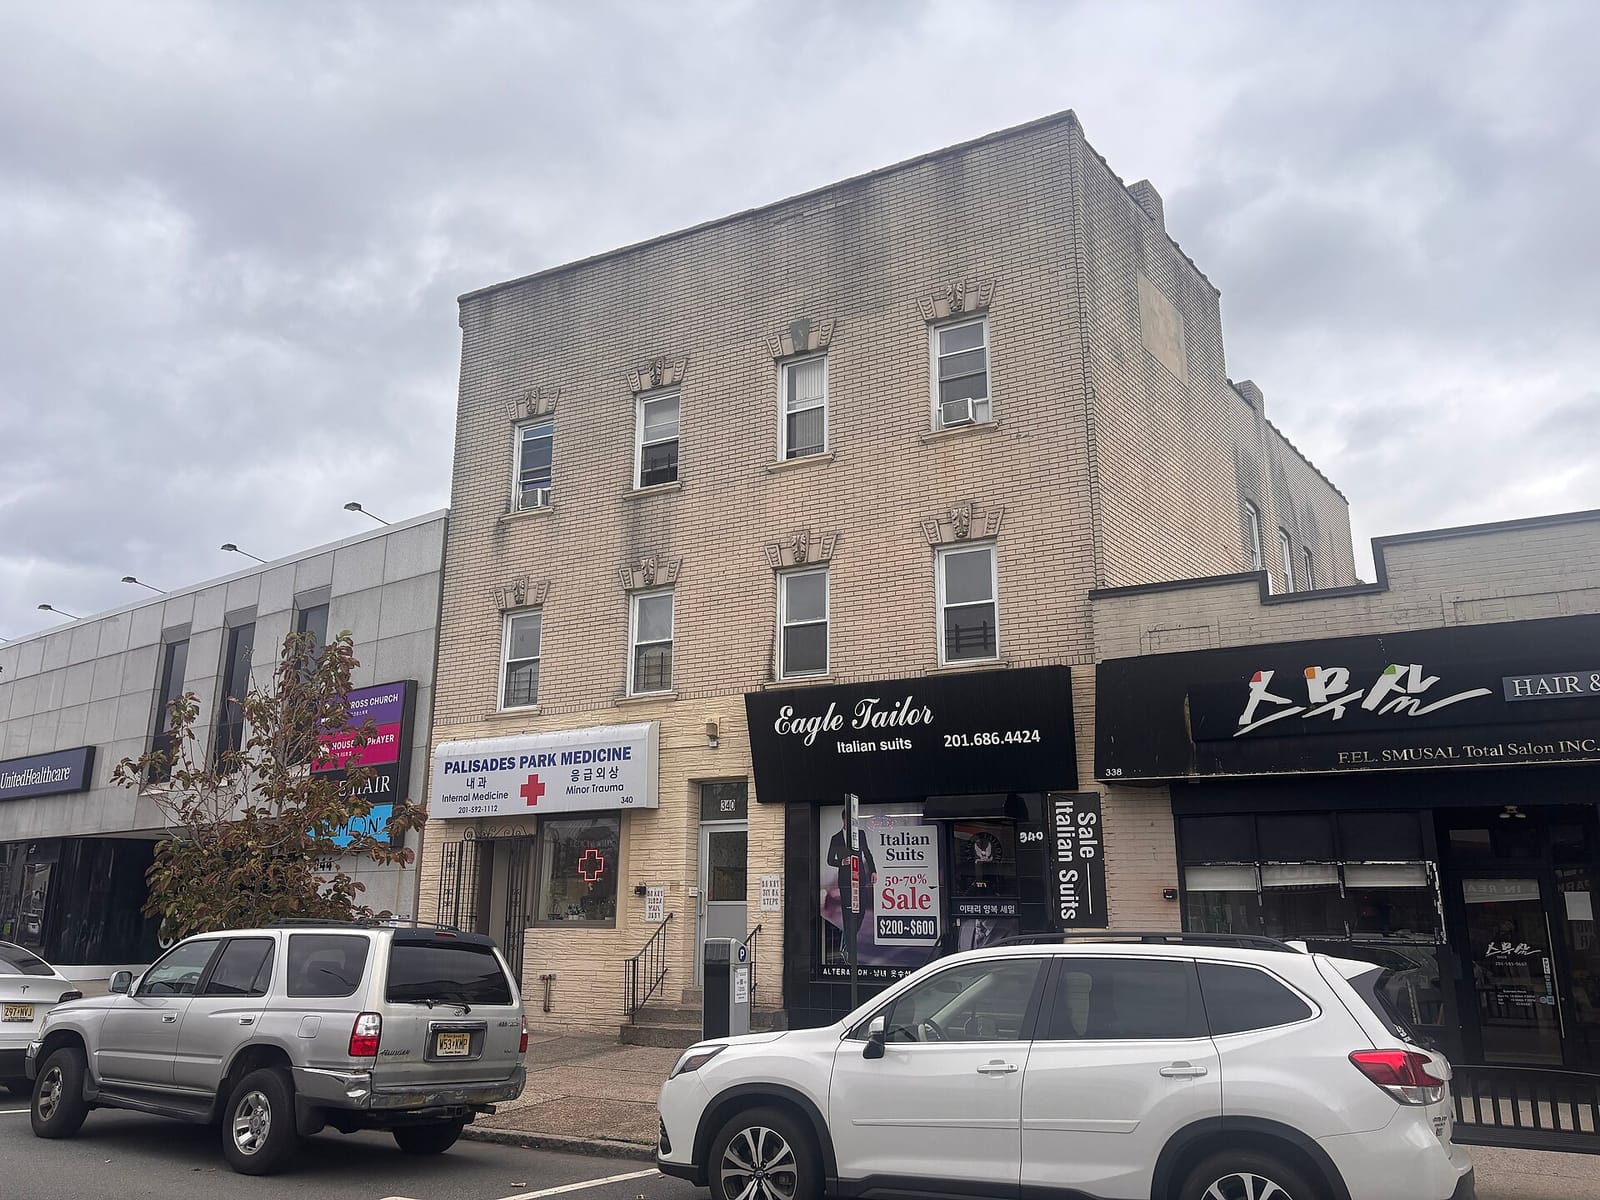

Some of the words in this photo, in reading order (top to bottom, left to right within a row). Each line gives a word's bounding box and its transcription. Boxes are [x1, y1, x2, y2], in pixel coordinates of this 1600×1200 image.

[1512, 676, 1584, 697] HAIR
[1589, 673, 1600, 692] &
[348, 698, 368, 710] ROSS
[369, 693, 399, 707] CHURCH
[774, 702, 844, 746] Eagle
[852, 696, 934, 729] Tailor
[837, 740, 876, 754] Italian
[880, 738, 912, 751] suits
[943, 729, 1041, 748] 201.686.4424
[1382, 746, 1460, 762] SMUSAL
[1462, 743, 1504, 757] Total
[1508, 742, 1555, 756] Salon
[1559, 739, 1600, 753] INC.
[444, 757, 516, 774] PALISADES
[519, 752, 557, 769] PARK
[560, 746, 632, 766] MEDICINE
[0, 765, 71, 789] UnitedHealthcare
[570, 766, 620, 782] 응급외상
[1105, 768, 1122, 776] 338
[466, 776, 488, 789] 내과
[565, 785, 590, 795] Minor
[592, 783, 624, 793] Trauma
[441, 793, 471, 803] Internal
[472, 790, 509, 802] Medicine
[620, 796, 634, 804] 340
[458, 805, 498, 814] 201-592-1112
[721, 800, 736, 811] 340
[328, 816, 381, 838] MON
[1055, 801, 1075, 862] Italian
[880, 832, 930, 846] Italian
[1020, 831, 1044, 843] 340
[1077, 812, 1098, 859] Sale
[886, 847, 925, 861] Suits
[885, 873, 927, 886] 50-70%
[881, 887, 931, 910] Sale
[1059, 869, 1079, 920] Suits
[960, 904, 981, 914] 이태리
[1000, 904, 1015, 914] 세일
[880, 919, 934, 936] $200~$600
[823, 968, 868, 976] ALTERAON
